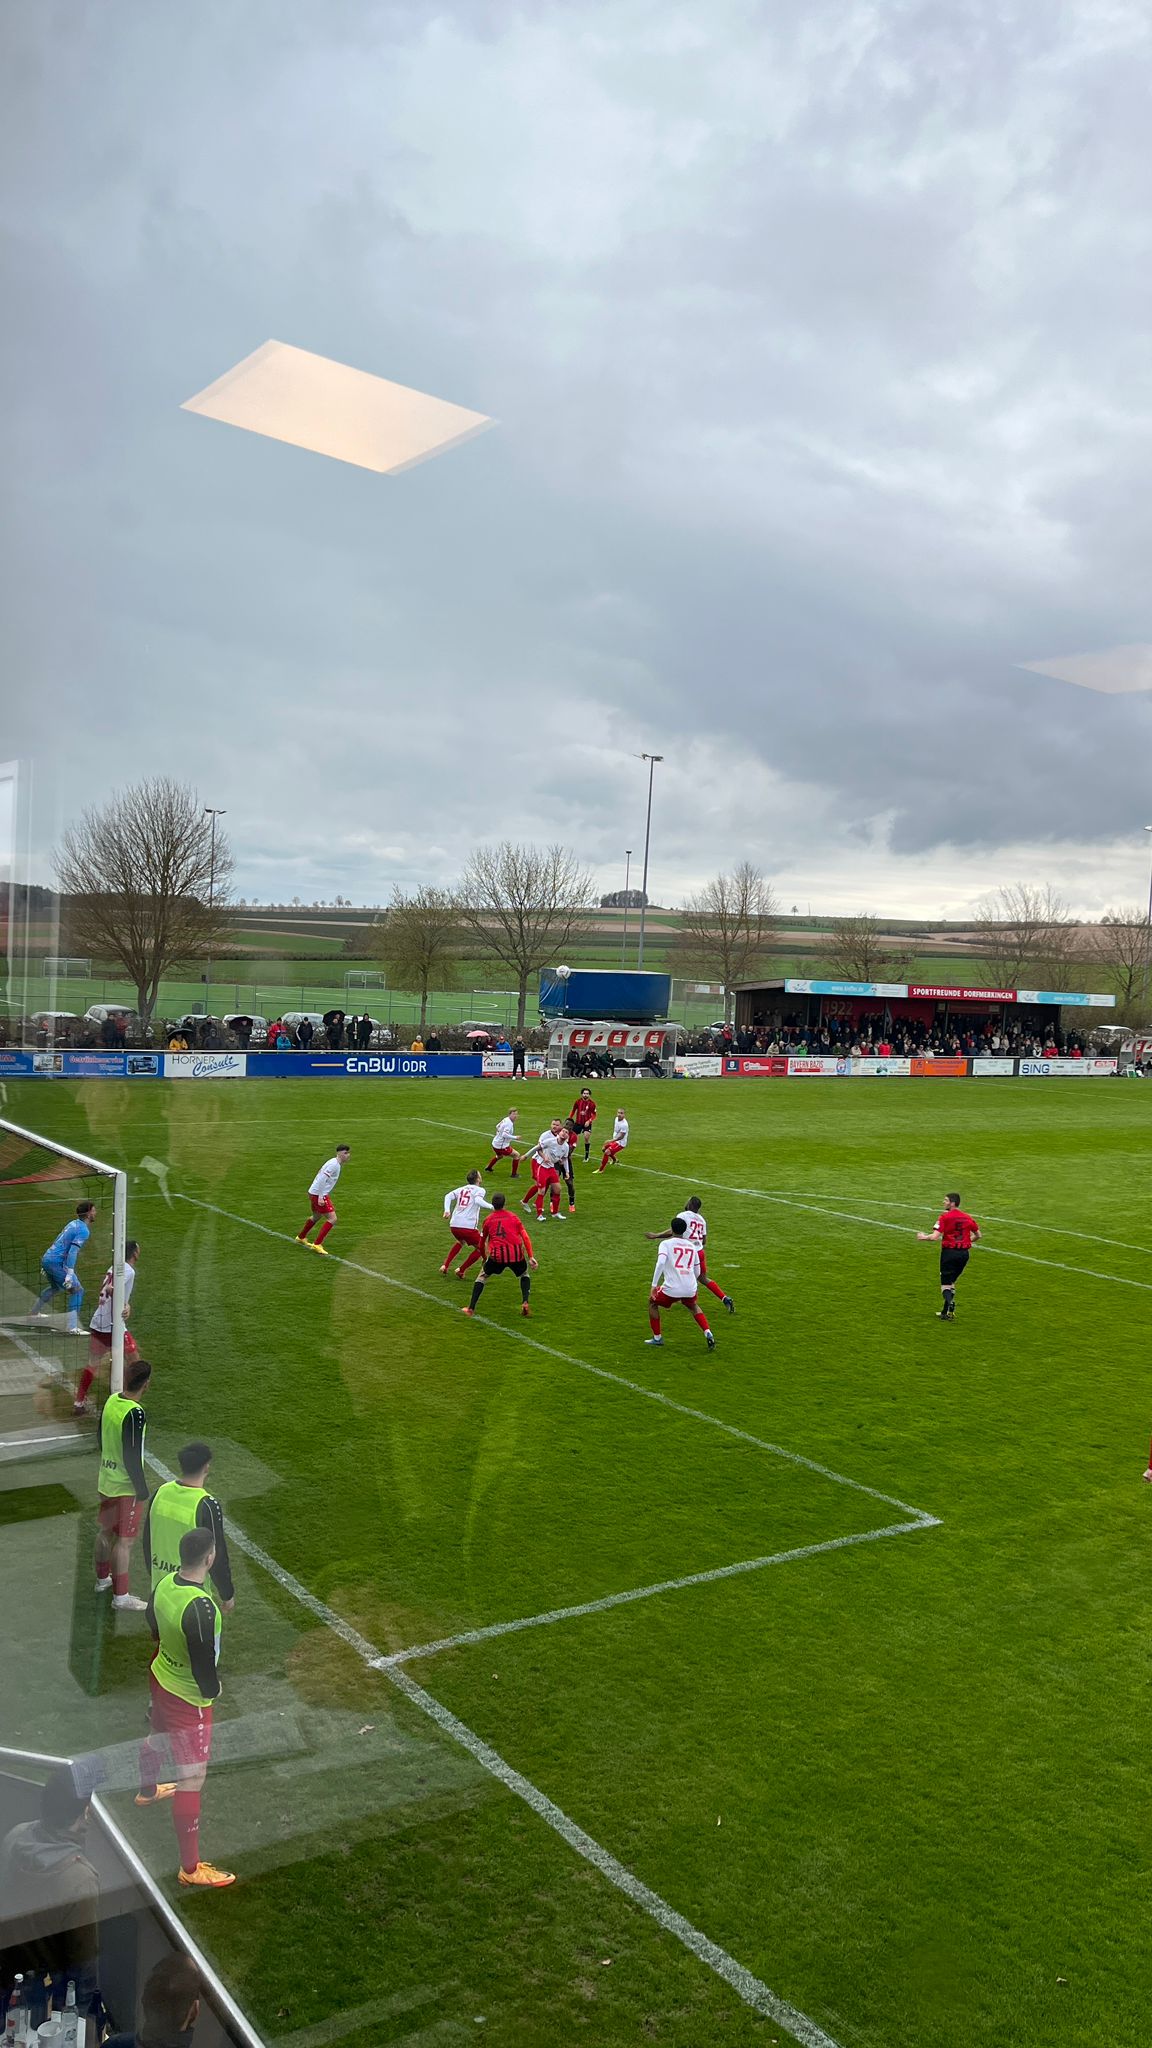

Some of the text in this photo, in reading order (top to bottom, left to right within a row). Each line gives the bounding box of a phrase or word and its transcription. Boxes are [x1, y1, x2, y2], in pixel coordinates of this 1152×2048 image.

[912, 987, 961, 998] SPORTFREUNDE
[963, 989, 1013, 1000] DORFMERKINGEN
[823, 1000, 853, 1015] 1922
[192, 1055, 234, 1077] Consult
[346, 1057, 427, 1073] EnBW ODR
[1021, 1063, 1050, 1074] SING
[458, 1189, 471, 1207] 15
[496, 1220, 507, 1238] 4
[673, 1247, 694, 1270] 27
[158, 1560, 181, 1573] JAK
